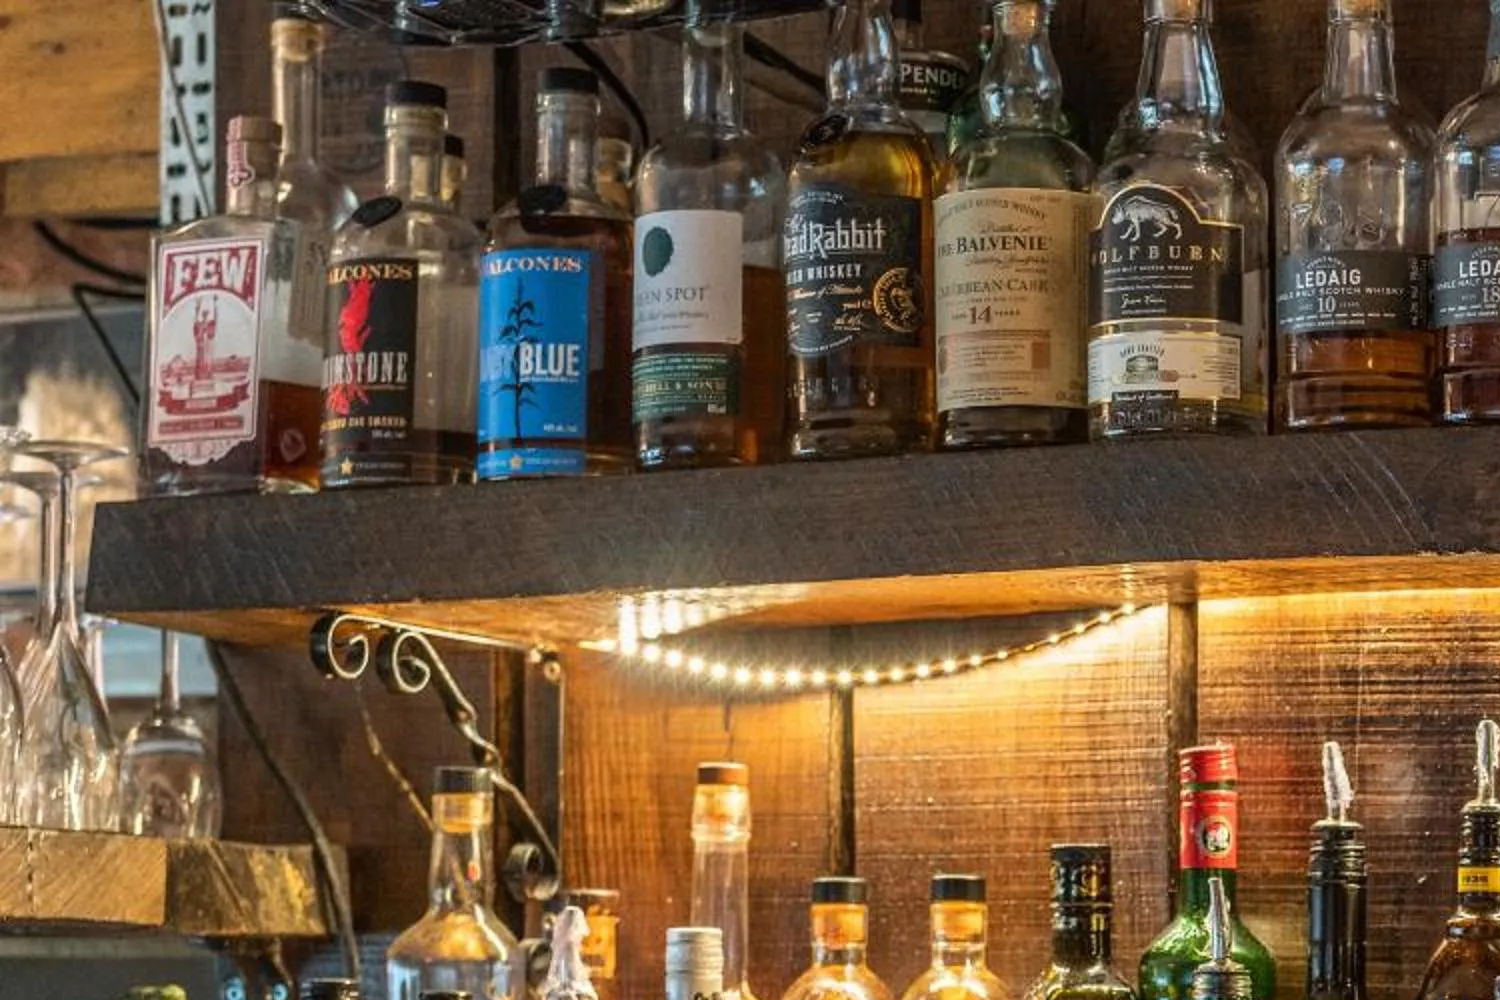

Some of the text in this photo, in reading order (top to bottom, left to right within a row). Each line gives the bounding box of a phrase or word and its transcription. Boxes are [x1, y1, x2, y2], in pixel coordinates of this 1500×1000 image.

[957, 236, 1049, 253] BALVENIE
[488, 256, 582, 275] ALCONES
[1092, 244, 1225, 268] OLFBURN
[171, 248, 249, 299] FEW
[329, 263, 413, 284] ALCONES
[1296, 268, 1361, 289] LEDAIG
[664, 286, 705, 303] SPOT
[1318, 287, 1361, 296] SCOTCH
[1481, 286, 1500, 303] 18
[1317, 295, 1336, 313] 10
[969, 305, 991, 325] 14
[519, 343, 580, 378] BLUE
